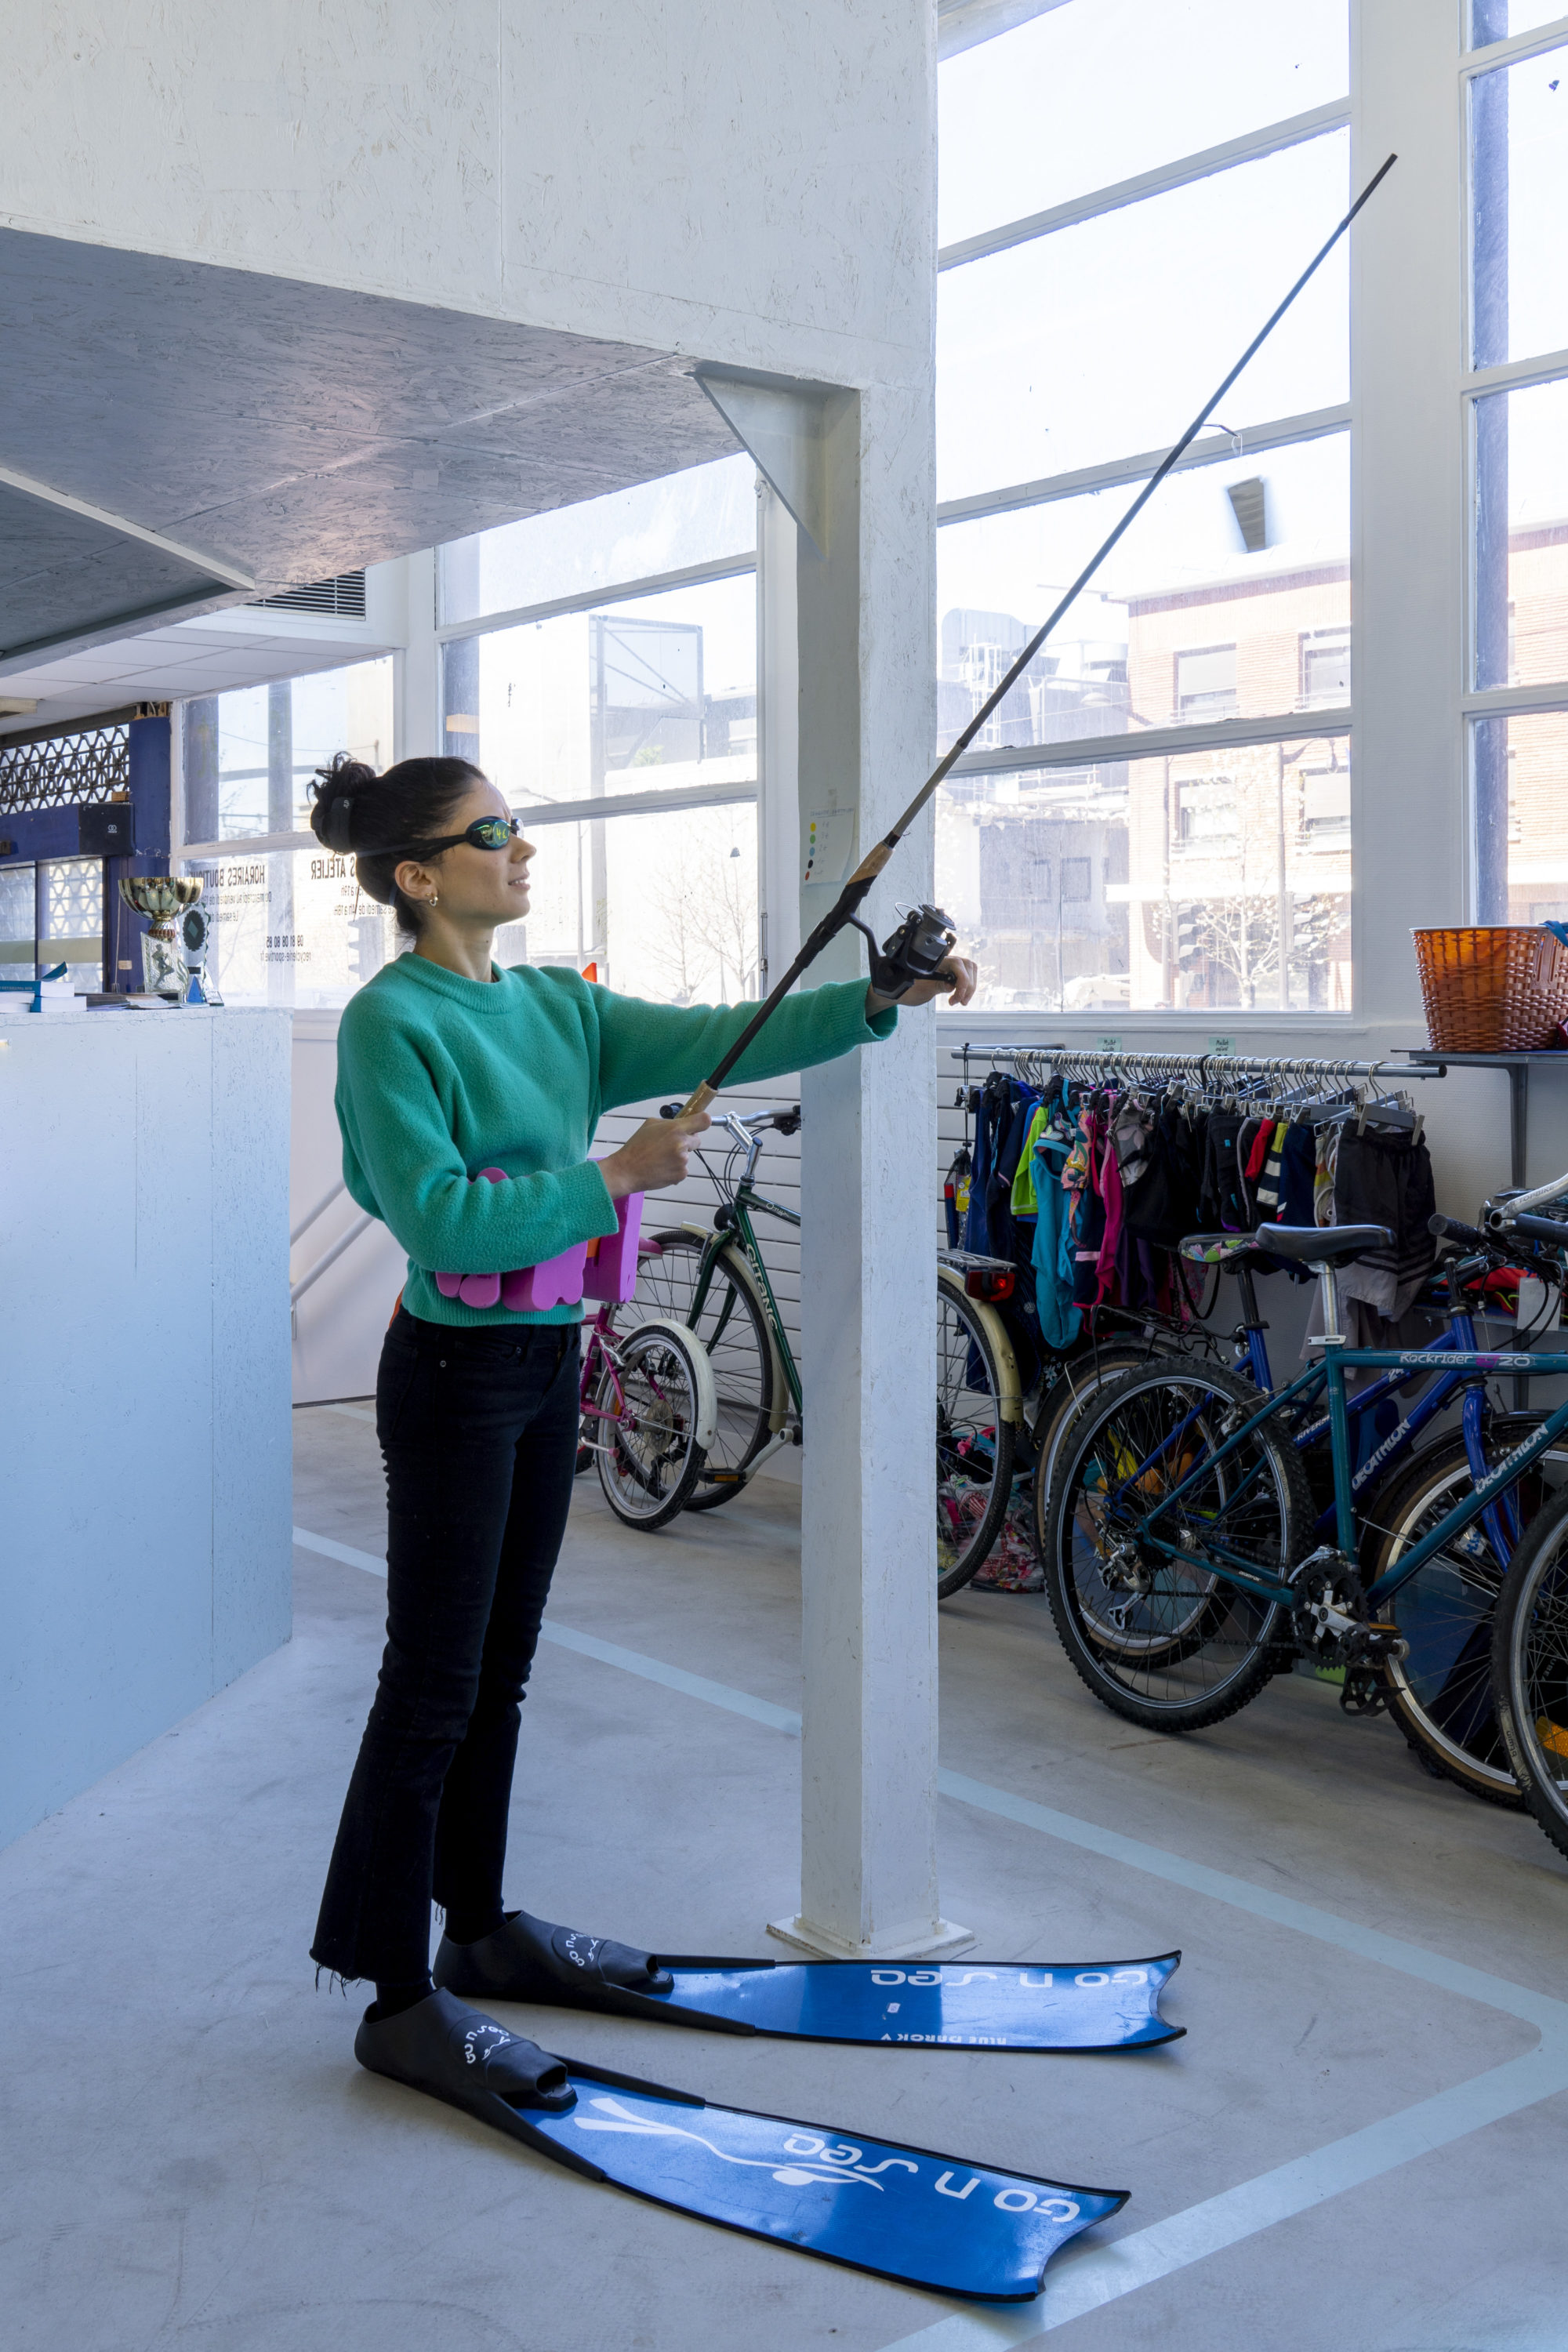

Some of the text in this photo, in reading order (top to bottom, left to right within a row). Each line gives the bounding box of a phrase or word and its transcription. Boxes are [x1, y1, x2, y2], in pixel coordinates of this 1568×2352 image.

[1399, 1352, 1474, 1365] Rockrider
[1297, 1414, 1330, 1441] RIVERS
[1352, 1417, 1412, 1490] DECATHLON
[1475, 1422, 1549, 1494] DECATHLON
